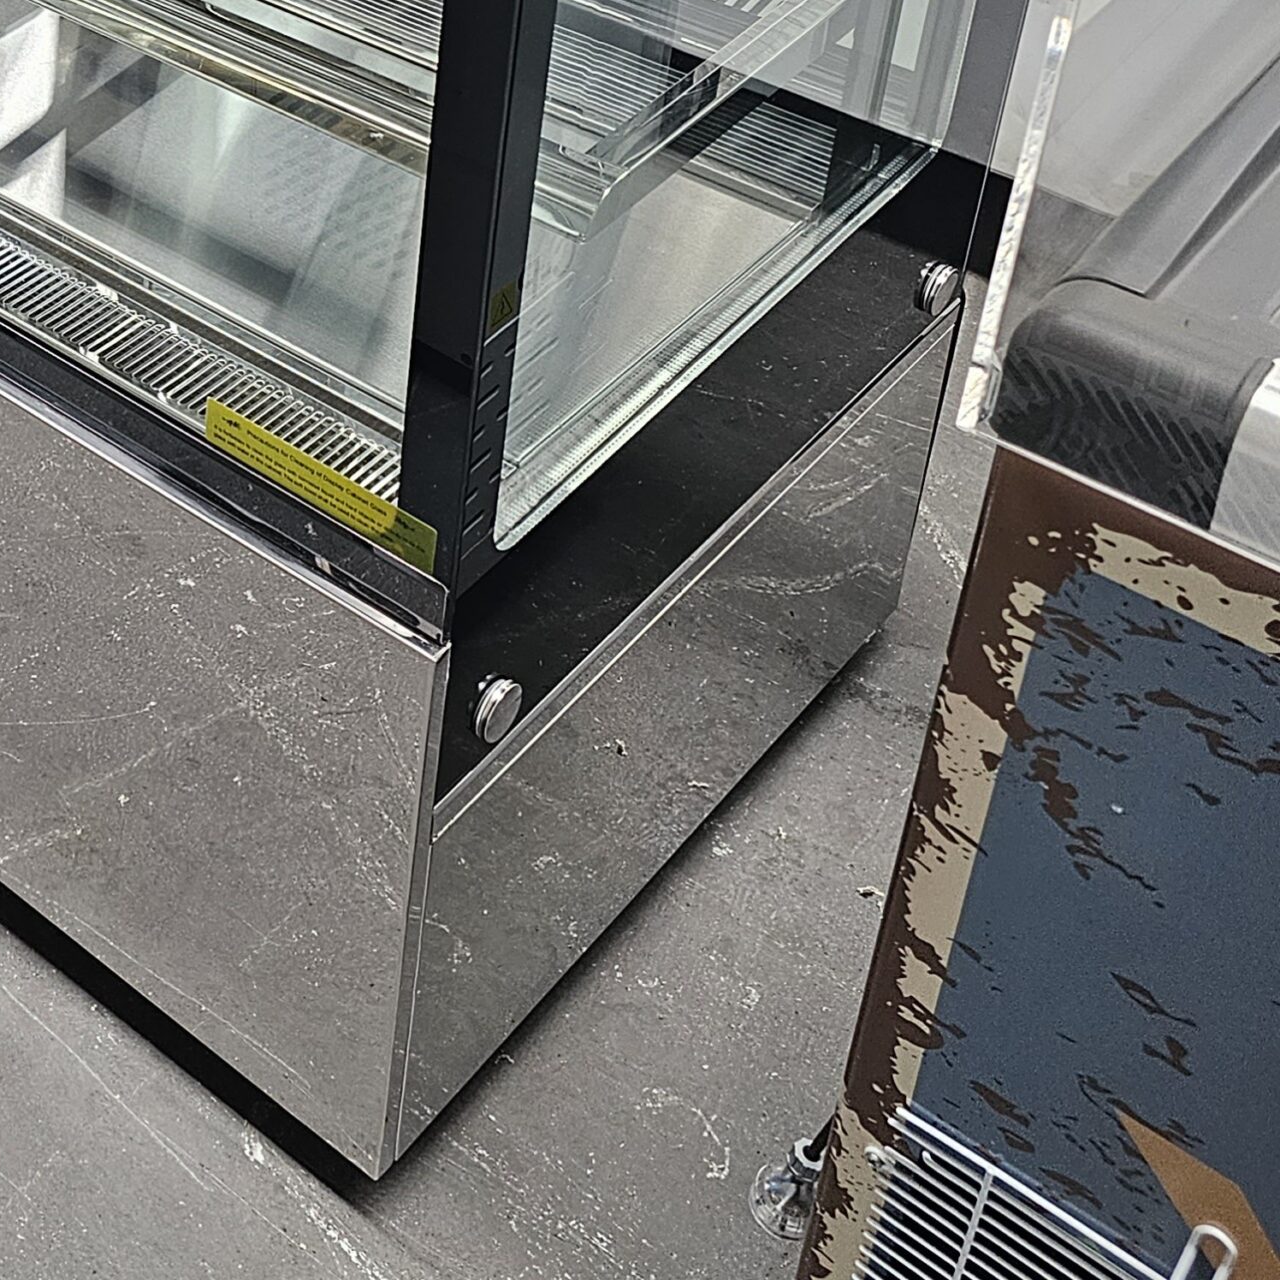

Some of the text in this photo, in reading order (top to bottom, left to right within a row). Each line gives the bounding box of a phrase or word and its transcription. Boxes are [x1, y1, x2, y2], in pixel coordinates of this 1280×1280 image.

[247, 428, 279, 453] Precautions
[280, 449, 288, 458] for
[289, 454, 315, 475] Cleaning
[323, 474, 344, 492] Display
[345, 487, 368, 506] Cabinet
[369, 501, 387, 517] Glass
